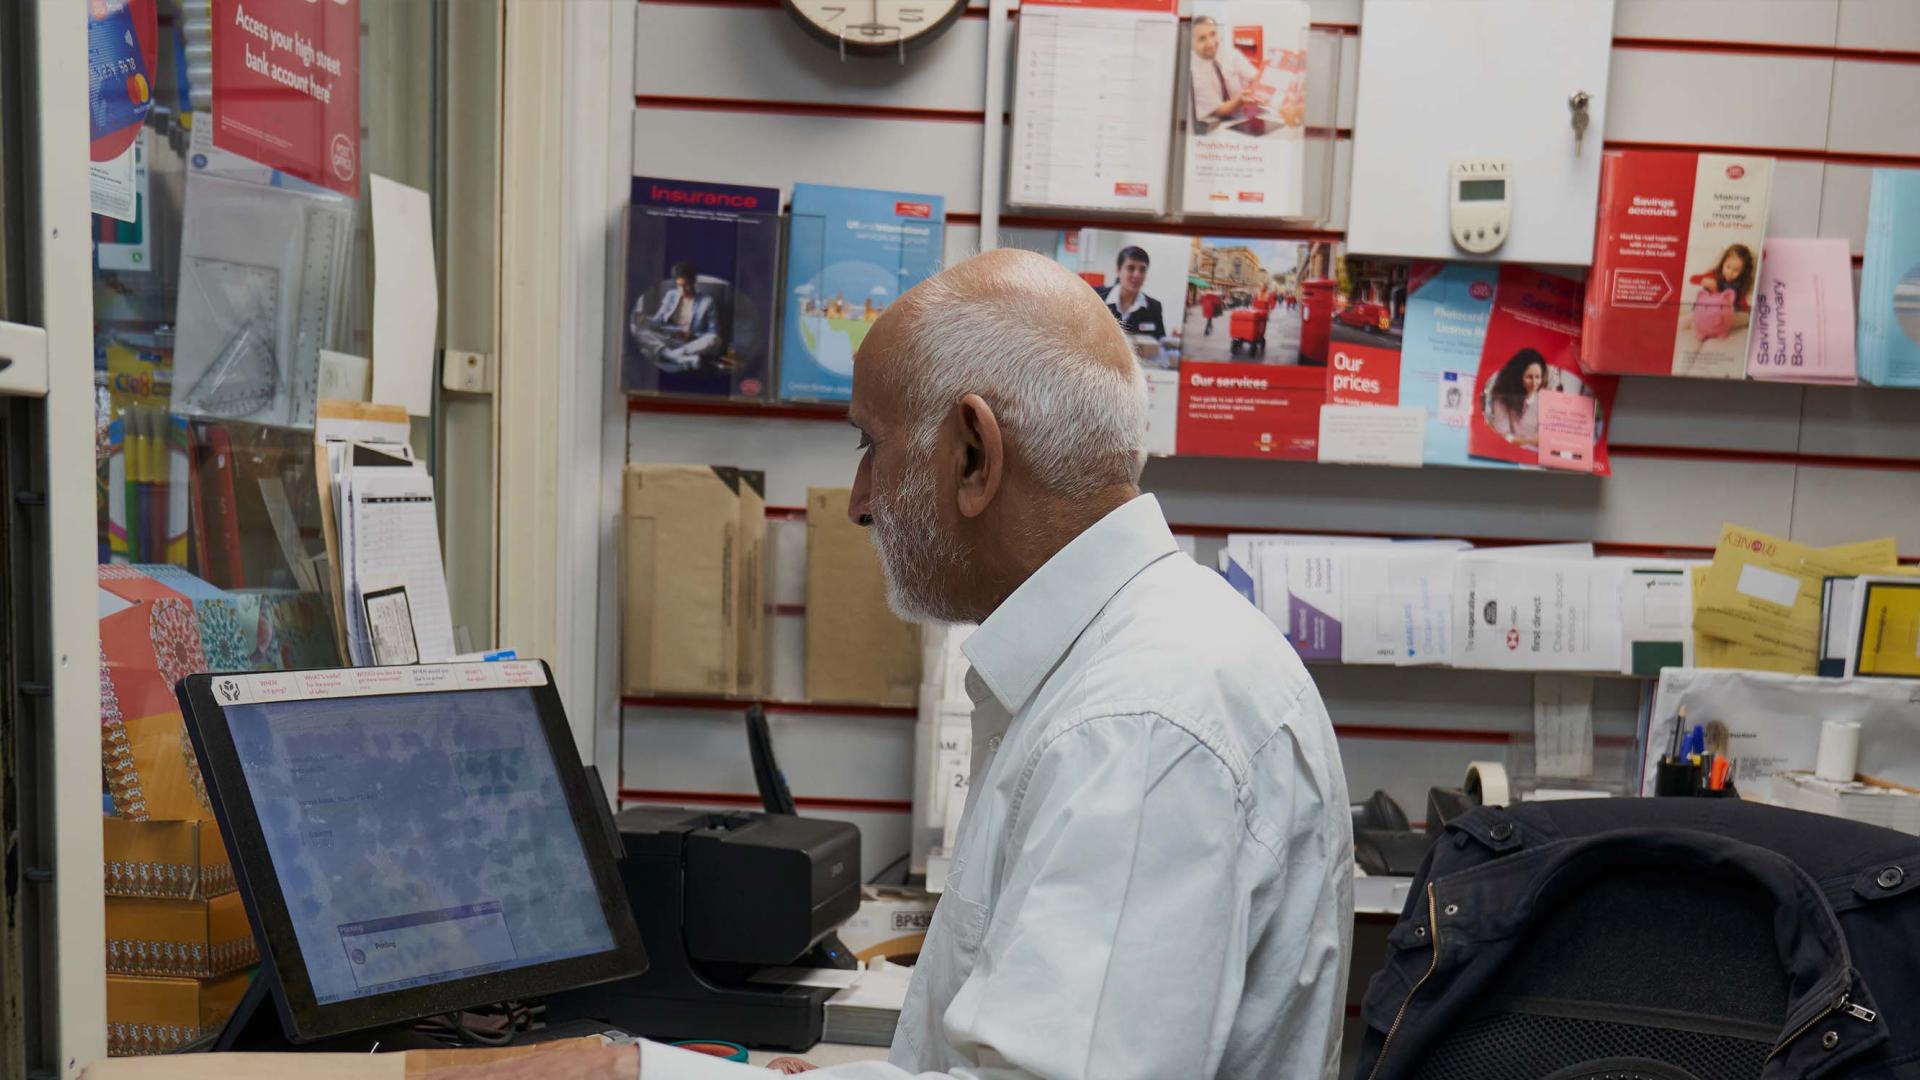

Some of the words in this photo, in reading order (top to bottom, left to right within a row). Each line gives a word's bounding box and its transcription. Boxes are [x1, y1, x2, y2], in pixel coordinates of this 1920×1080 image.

[821, 6, 846, 23] 7
[235, 3, 269, 41] Access
[270, 27, 293, 52] your
[294, 31, 315, 68] high
[316, 50, 341, 77] street
[245, 42, 269, 78] bank
[271, 63, 309, 95] account
[651, 184, 759, 209] Insurance
[1632, 196, 1675, 209] Savings
[1627, 207, 1678, 217] accounts
[1757, 294, 1771, 366] Savings
[1773, 278, 1787, 367] Summary
[1333, 351, 1364, 372] Our
[1791, 331, 1804, 368] Box
[1191, 373, 1214, 387] Our
[1216, 375, 1268, 390] services
[1333, 372, 1380, 394] prices
[1532, 596, 1541, 629] direct
[1530, 630, 1541, 653] first
